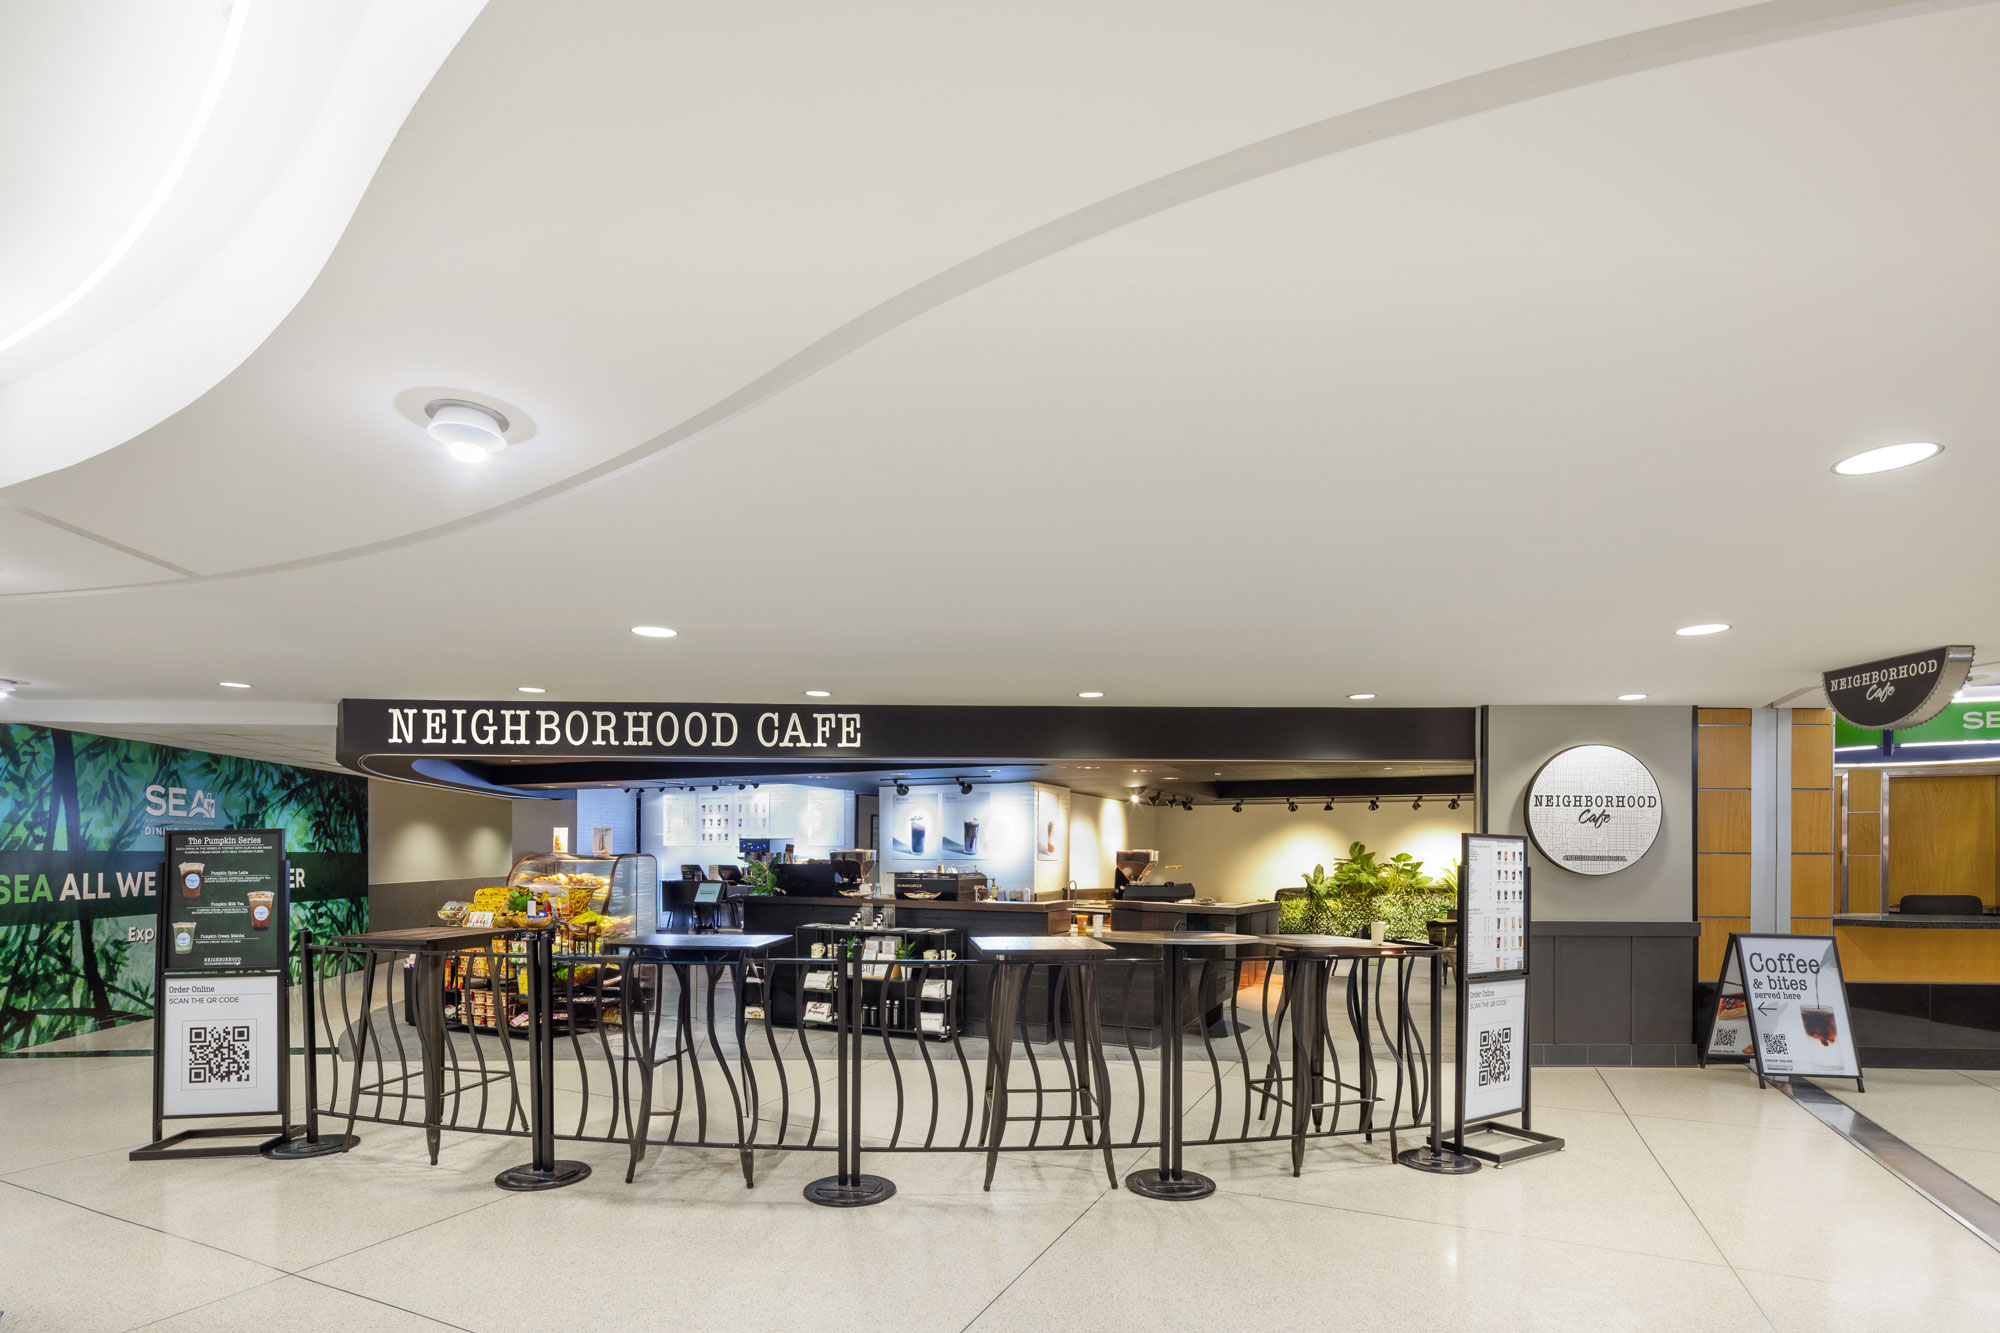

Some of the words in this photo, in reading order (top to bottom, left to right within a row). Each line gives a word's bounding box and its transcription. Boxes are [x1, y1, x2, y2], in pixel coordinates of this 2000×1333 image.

[1830, 659, 1938, 692] NEIGHBORHOOD
[1866, 682, 1895, 703] Cafe
[388, 708, 738, 747] NEIGHBORHOOD
[757, 712, 861, 748] CAFE
[145, 784, 217, 819] SEA
[1533, 794, 1657, 808] NEIGHBORHOOD
[1578, 809, 1611, 829] Cafe
[204, 836, 236, 846] Pumpkin
[238, 836, 262, 844] Series
[0, 874, 54, 904] SEA
[59, 872, 110, 902] ALL
[116, 872, 156, 898] WE
[1750, 952, 1820, 975] Coffee
[1753, 978, 1763, 989] &
[1767, 975, 1808, 990] bites
[1783, 991, 1801, 1000] here
